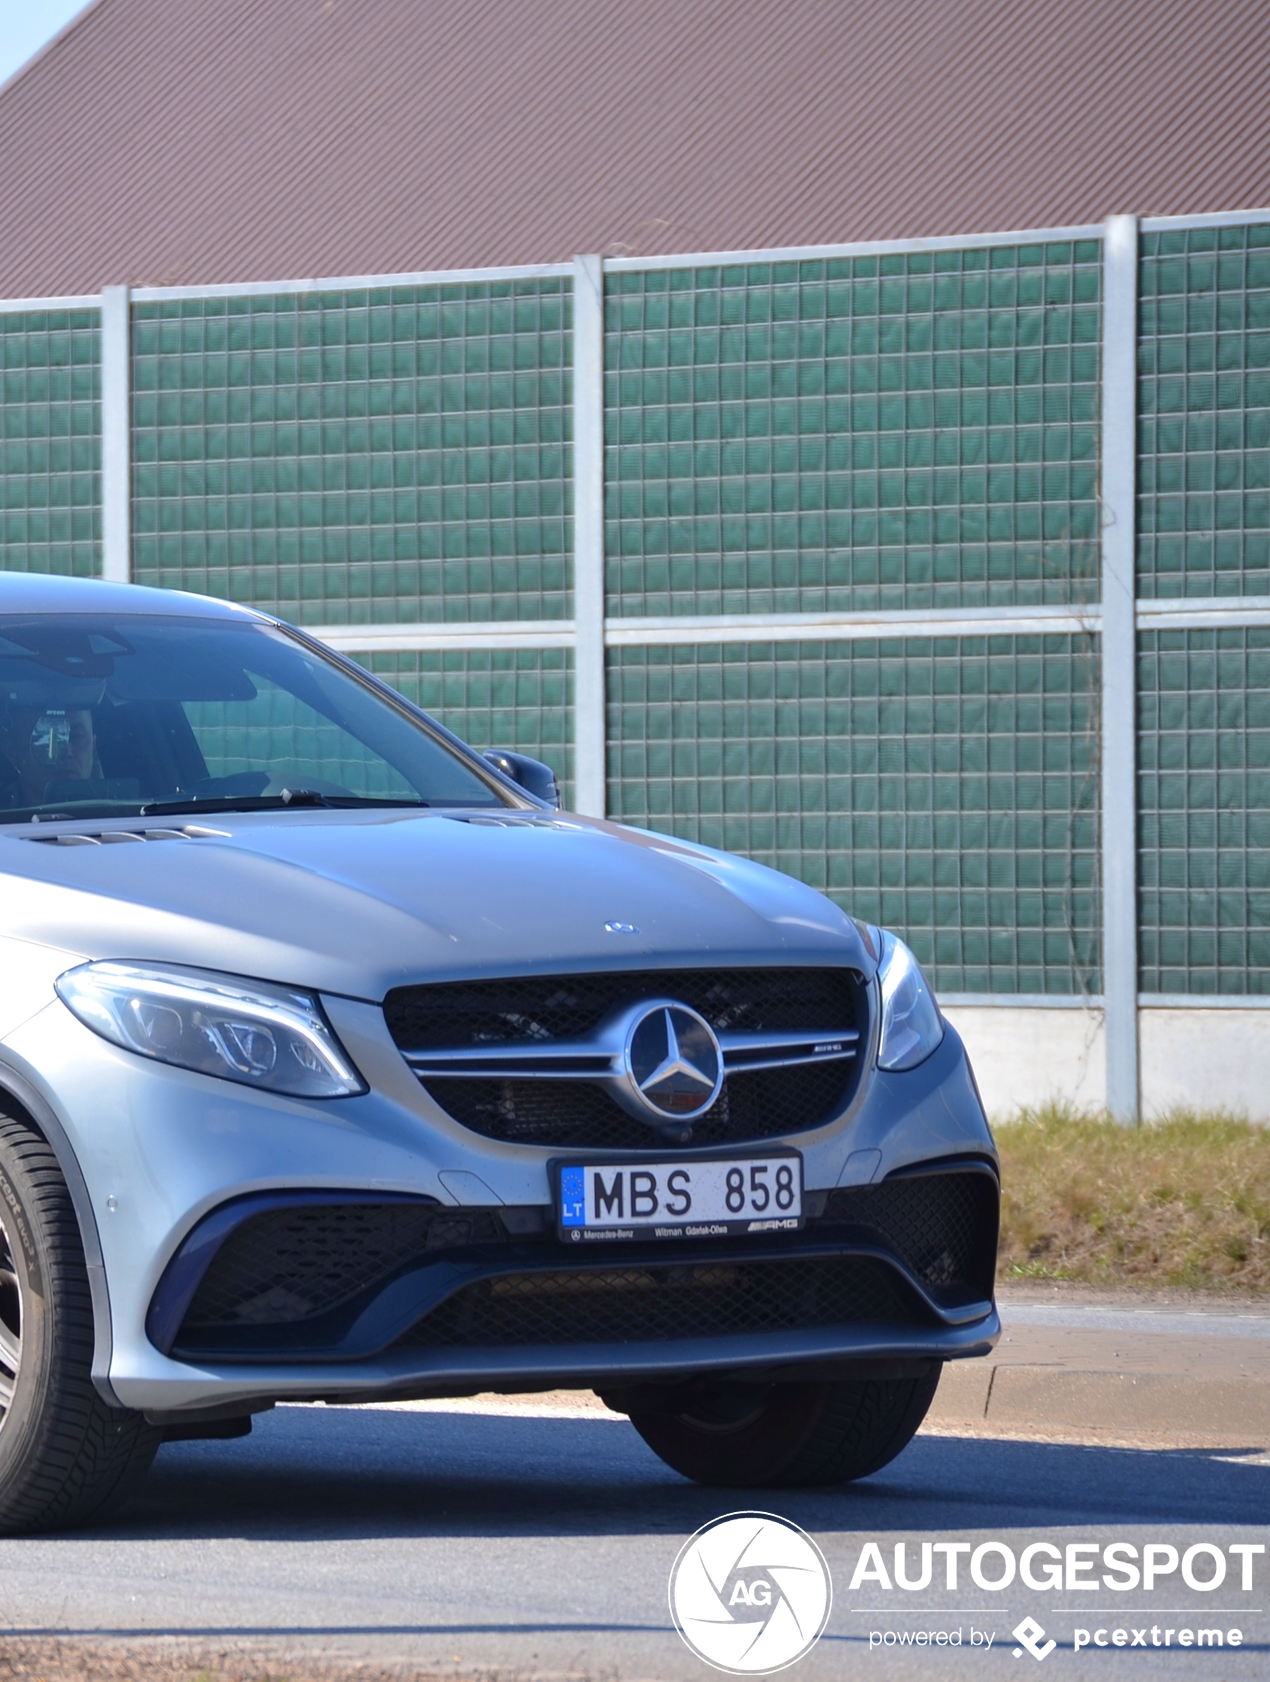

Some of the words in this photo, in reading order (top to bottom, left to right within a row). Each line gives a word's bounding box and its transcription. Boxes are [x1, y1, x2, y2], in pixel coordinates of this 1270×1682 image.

[593, 1169, 692, 1219] MBS
[725, 1165, 794, 1213] 858
[563, 1203, 582, 1218] LT
[584, 1229, 634, 1240] Mercedes-Benz
[655, 1227, 683, 1237] Witman
